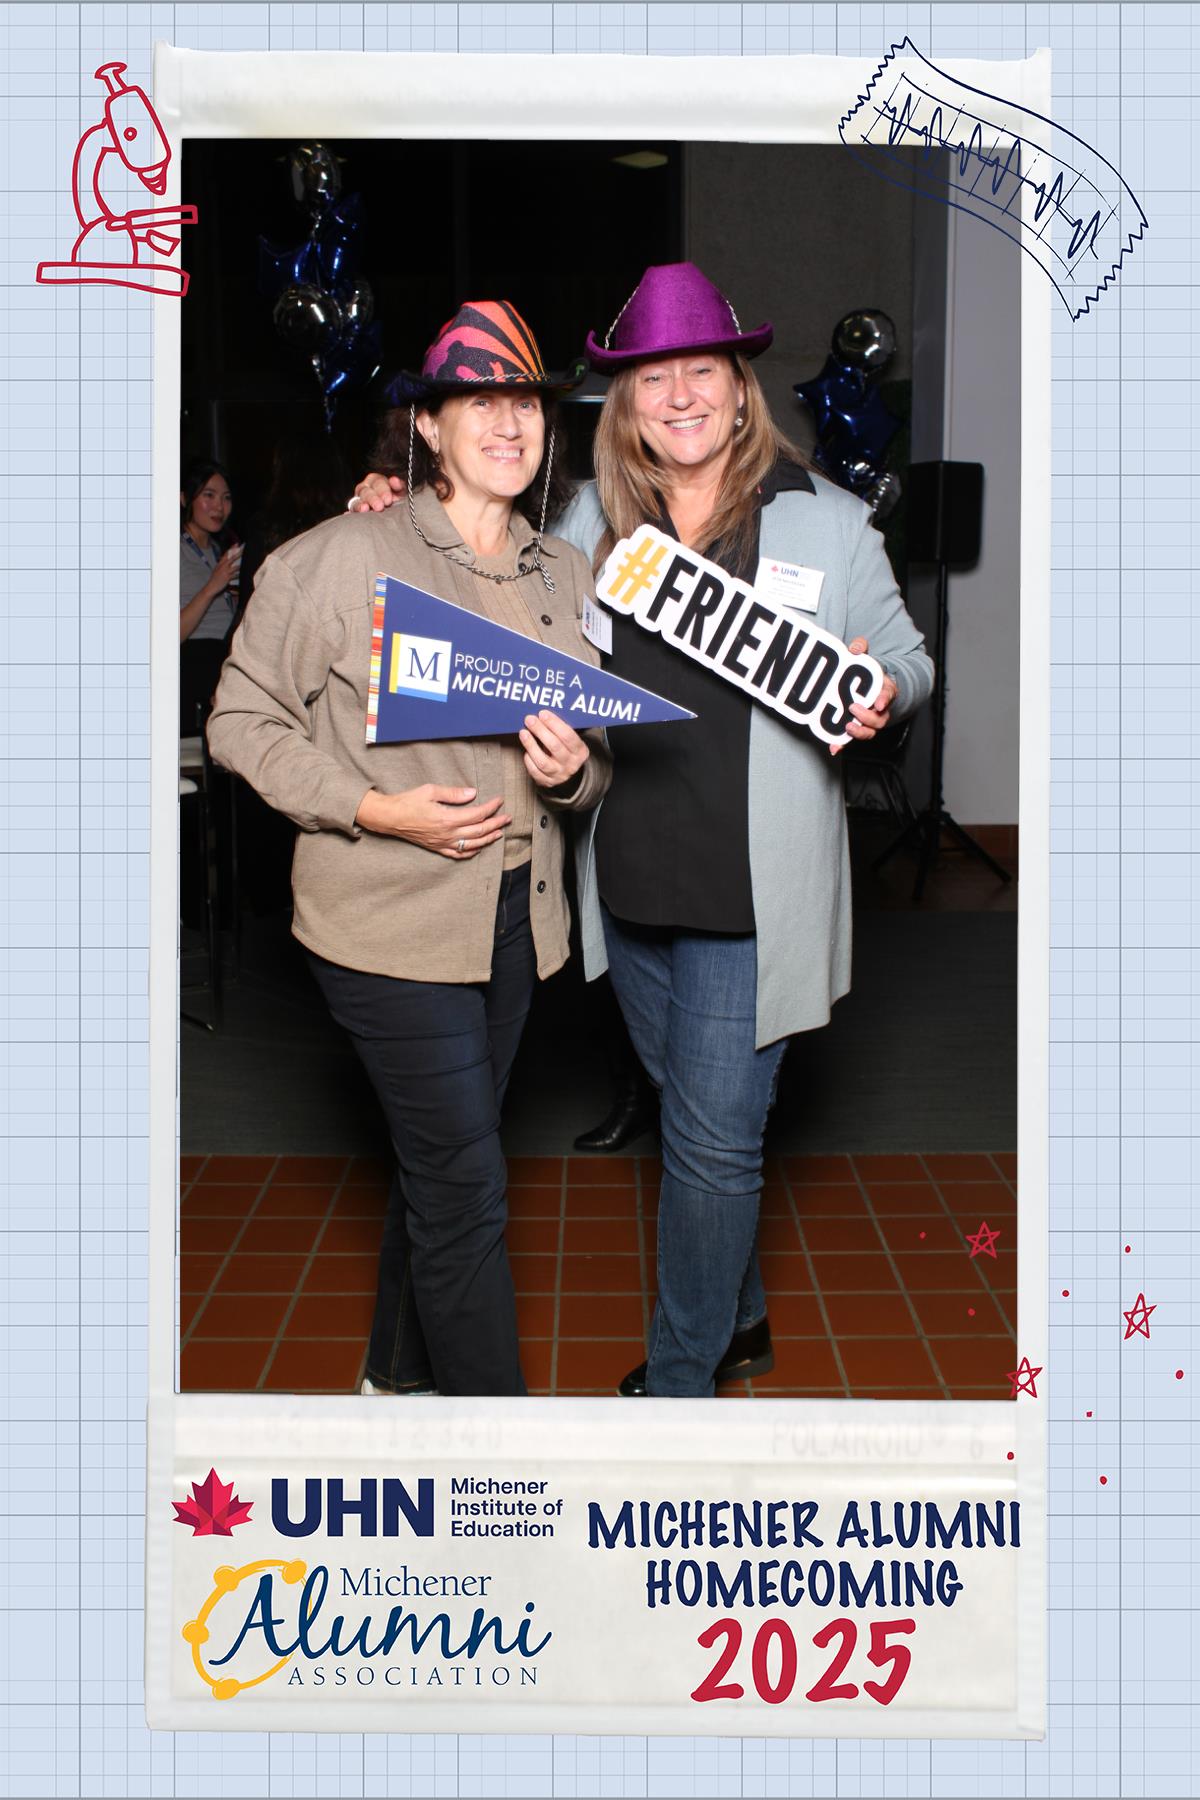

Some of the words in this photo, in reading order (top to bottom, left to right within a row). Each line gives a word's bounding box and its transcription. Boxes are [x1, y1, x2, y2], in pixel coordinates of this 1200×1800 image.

[780, 567, 799, 578] UHN
[606, 536, 874, 737] #FRIENDS
[406, 646, 444, 683] M
[454, 652, 514, 678] PROUD
[518, 663, 541, 682] TO
[545, 668, 566, 687] BE
[568, 673, 583, 690] A
[451, 671, 566, 709] MICHENER
[569, 693, 641, 722] ALUM!
